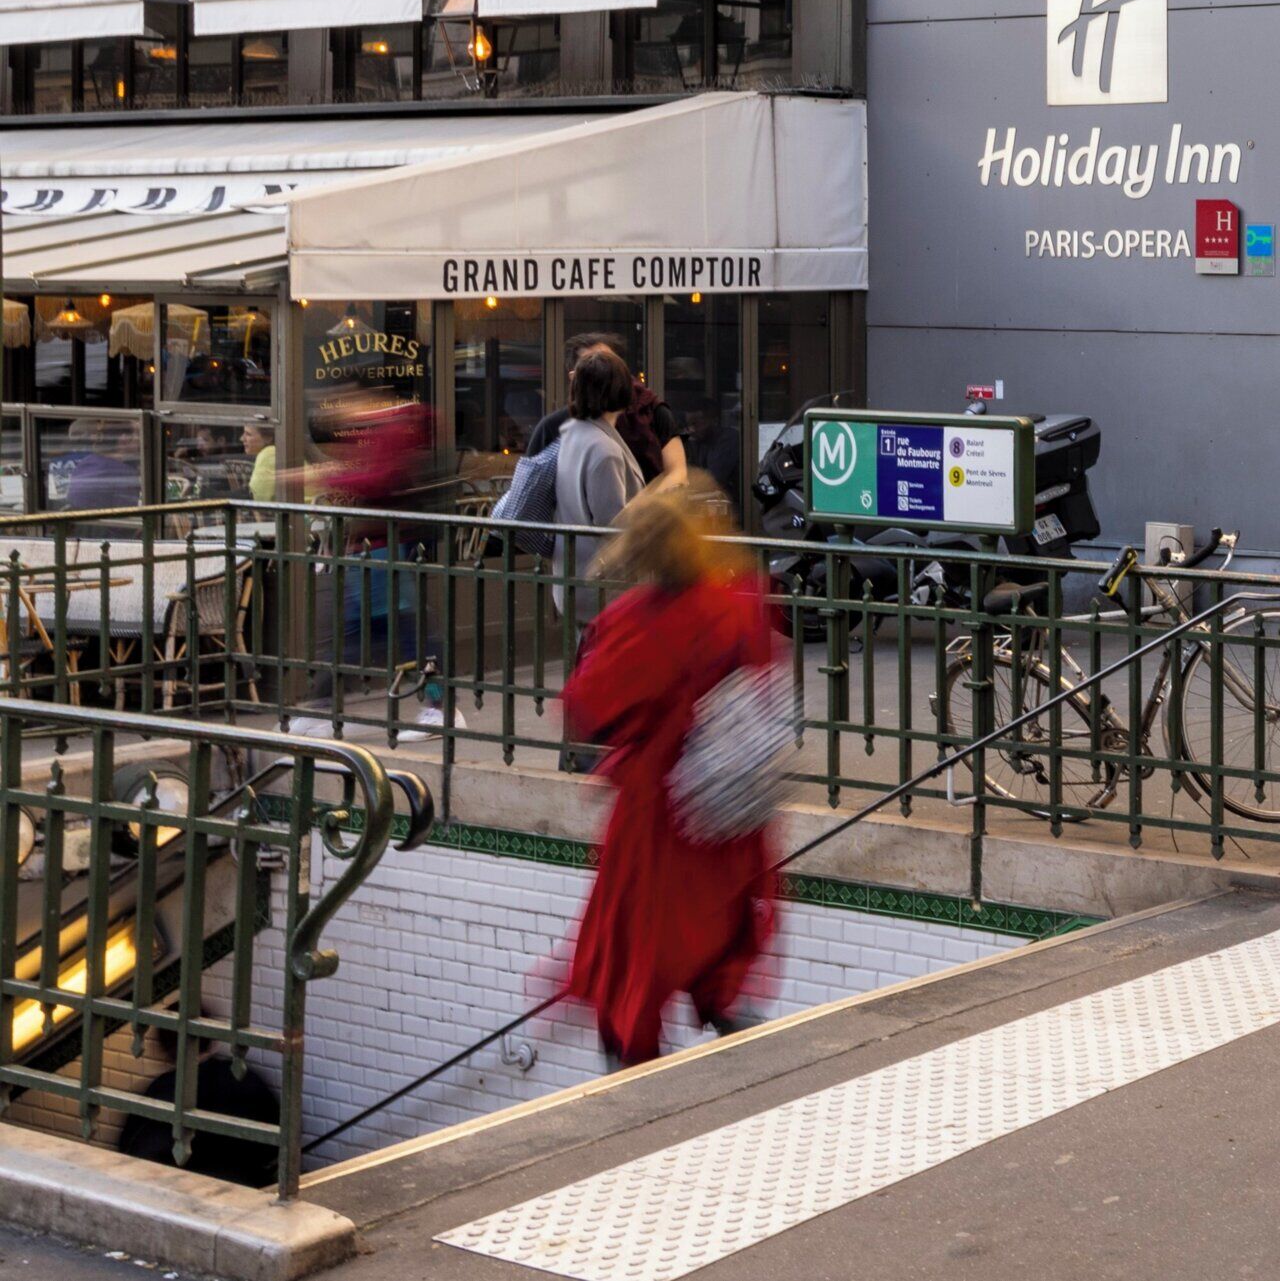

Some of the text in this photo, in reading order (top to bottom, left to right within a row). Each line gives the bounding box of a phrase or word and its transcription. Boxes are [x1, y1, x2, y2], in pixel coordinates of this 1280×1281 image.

[977, 123, 1242, 199] Holiday Inn
[1216, 210, 1232, 232] H
[1025, 228, 1192, 258] PARIS-OPERA
[442, 256, 761, 293] GRAND CAFE COMPTOIR
[318, 331, 420, 364] HEURES
[819, 431, 846, 471] M
[897, 437, 910, 446] rue
[953, 440, 960, 455] 8
[896, 446, 941, 460] du Faubourg
[897, 457, 940, 470] Montmartre
[952, 470, 960, 484] 9
